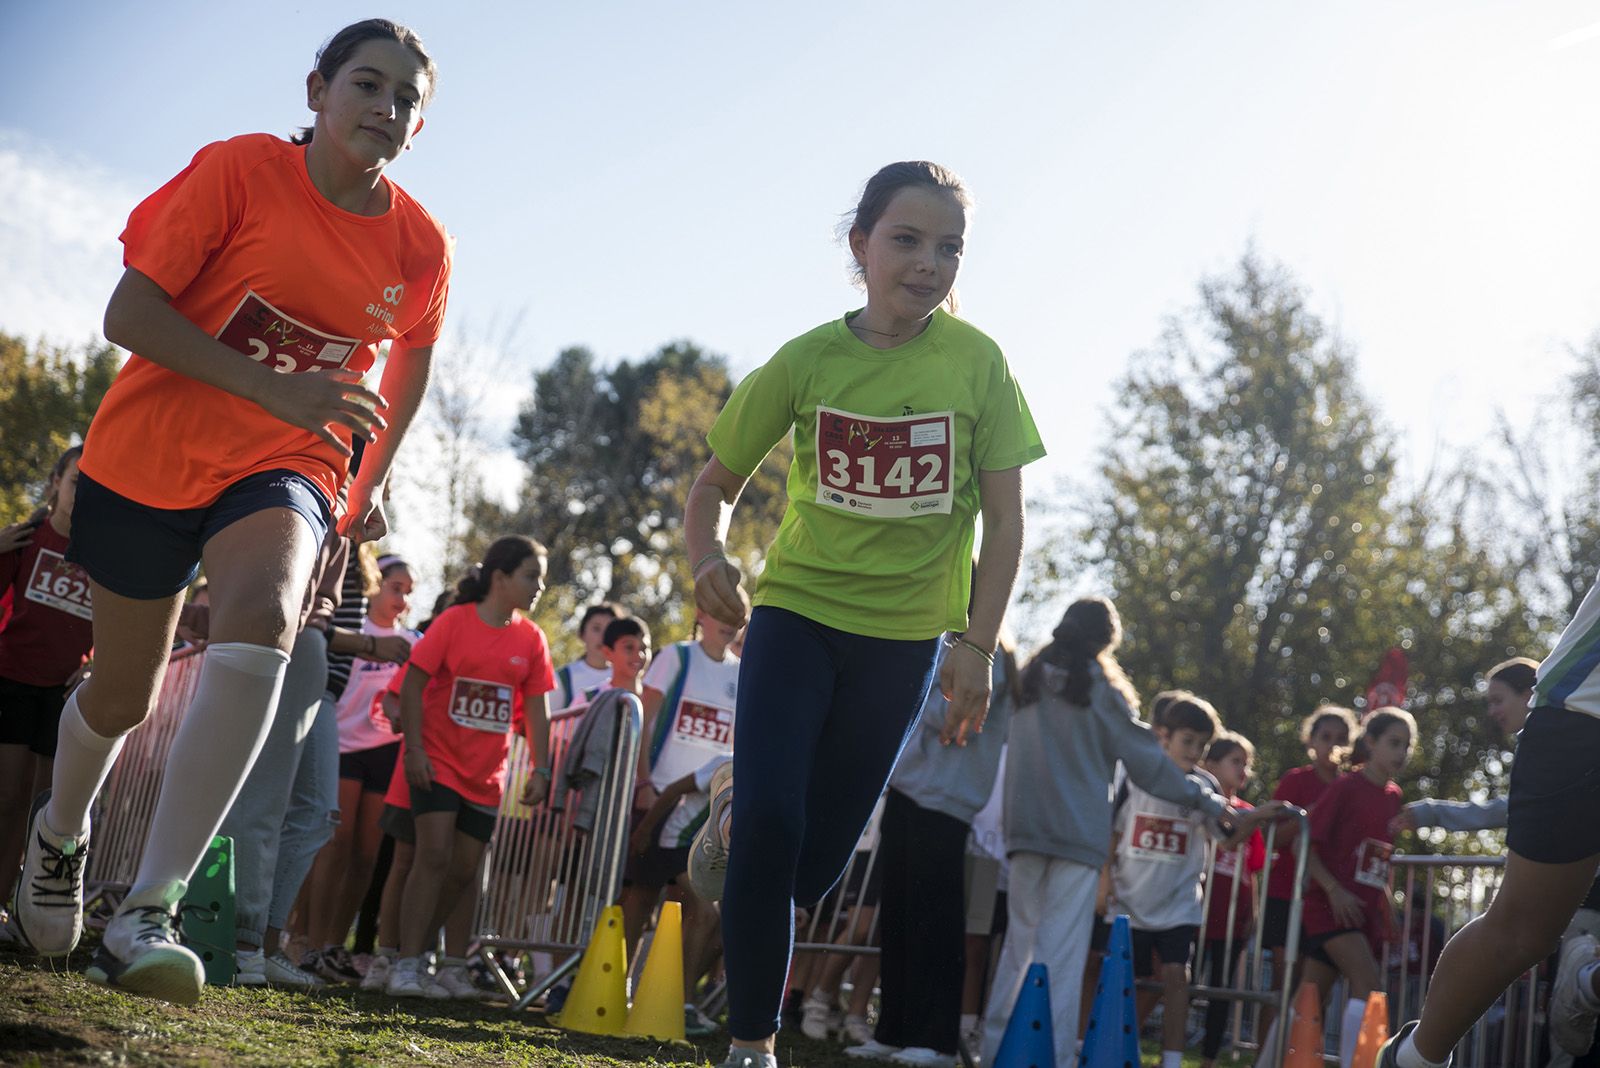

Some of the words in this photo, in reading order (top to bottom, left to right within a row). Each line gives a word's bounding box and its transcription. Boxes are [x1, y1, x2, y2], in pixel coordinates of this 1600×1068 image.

[826, 449, 943, 495] 3142
[454, 695, 509, 721] 1016
[680, 714, 728, 742] 3537
[1140, 830, 1180, 852] 613
